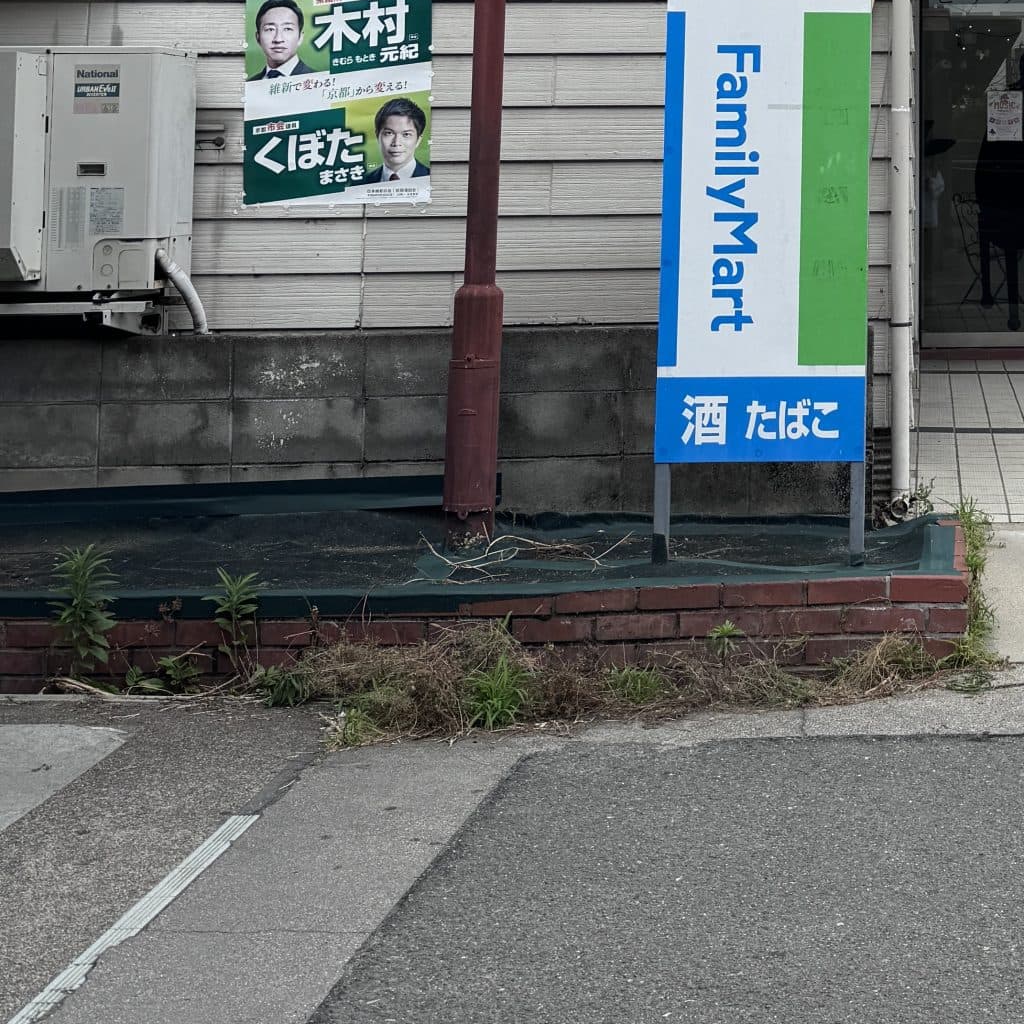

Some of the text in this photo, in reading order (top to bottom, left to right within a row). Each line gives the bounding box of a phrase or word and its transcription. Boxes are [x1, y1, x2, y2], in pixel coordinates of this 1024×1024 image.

[380, 44, 419, 63] 元紀
[77, 69, 119, 78] National
[254, 128, 363, 174] くぼた
[320, 165, 365, 185] まさき
[706, 44, 761, 332] FamilyMart
[681, 394, 839, 445] 酒 たばこ
